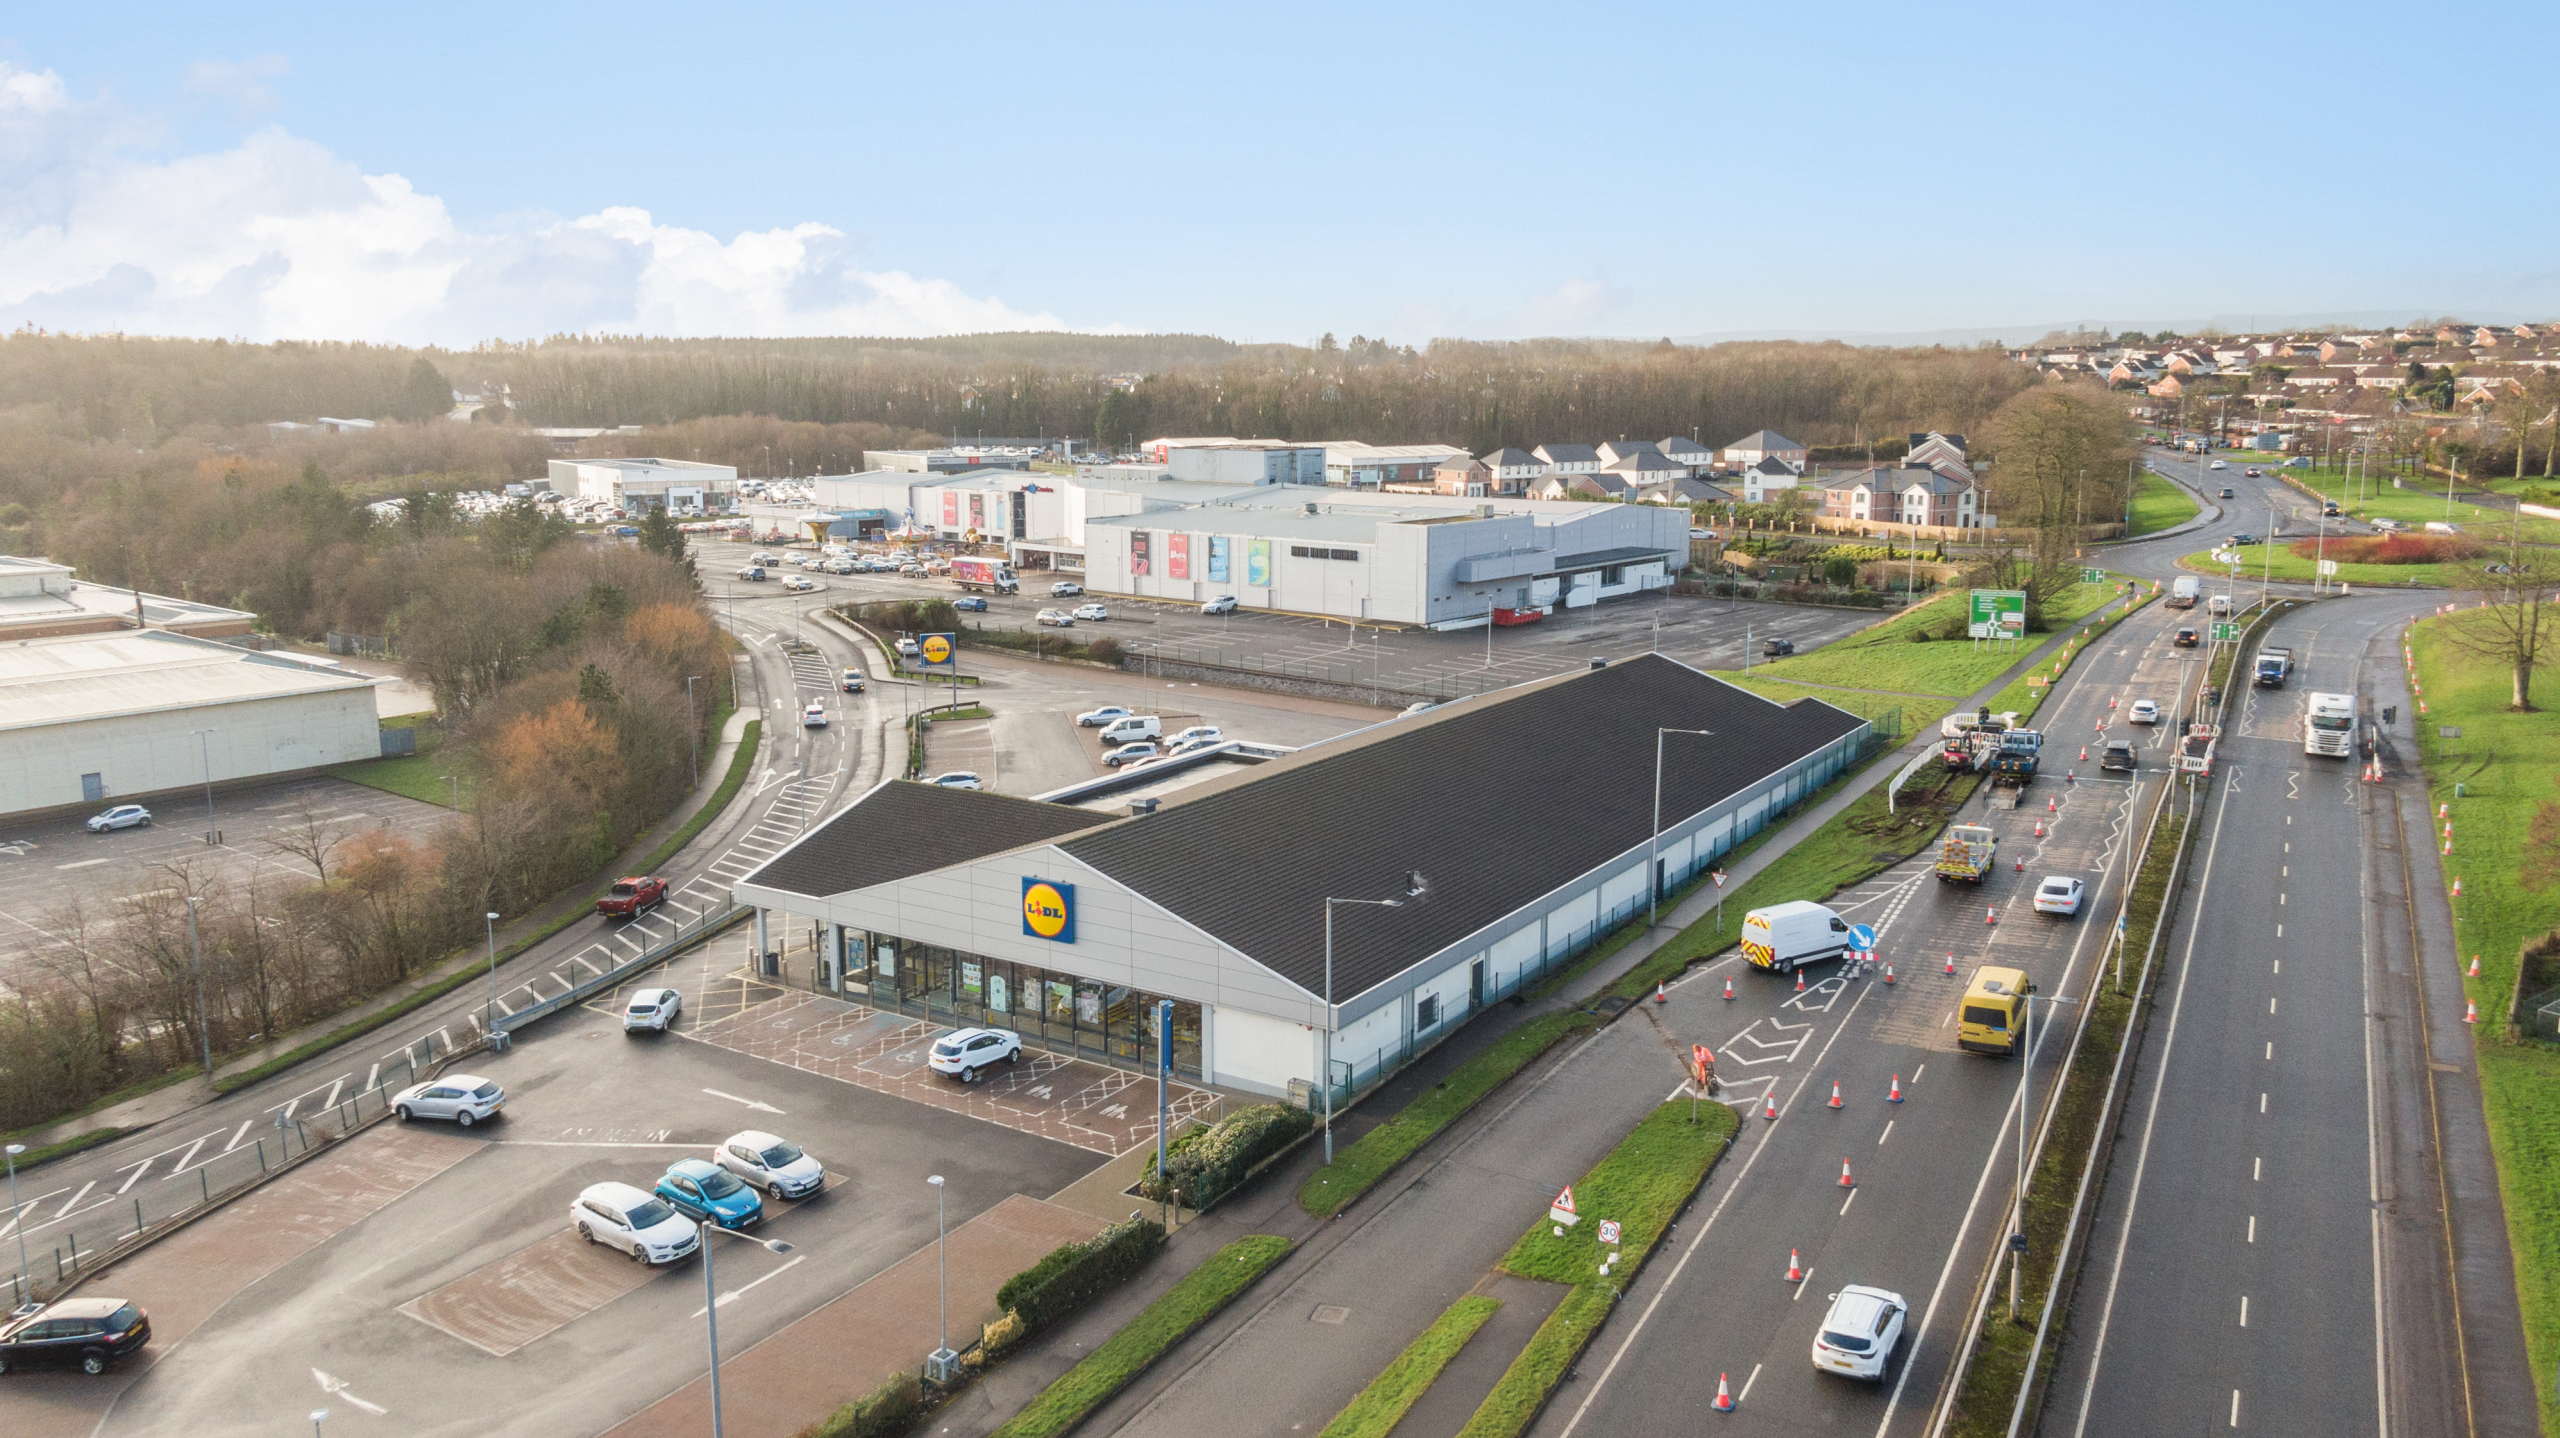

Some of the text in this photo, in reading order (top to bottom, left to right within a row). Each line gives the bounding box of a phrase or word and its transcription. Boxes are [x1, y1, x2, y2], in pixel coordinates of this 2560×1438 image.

[925, 644, 948, 654] LIDL
[1027, 900, 1063, 919] LIDL
[1602, 1226, 1617, 1237] 30
